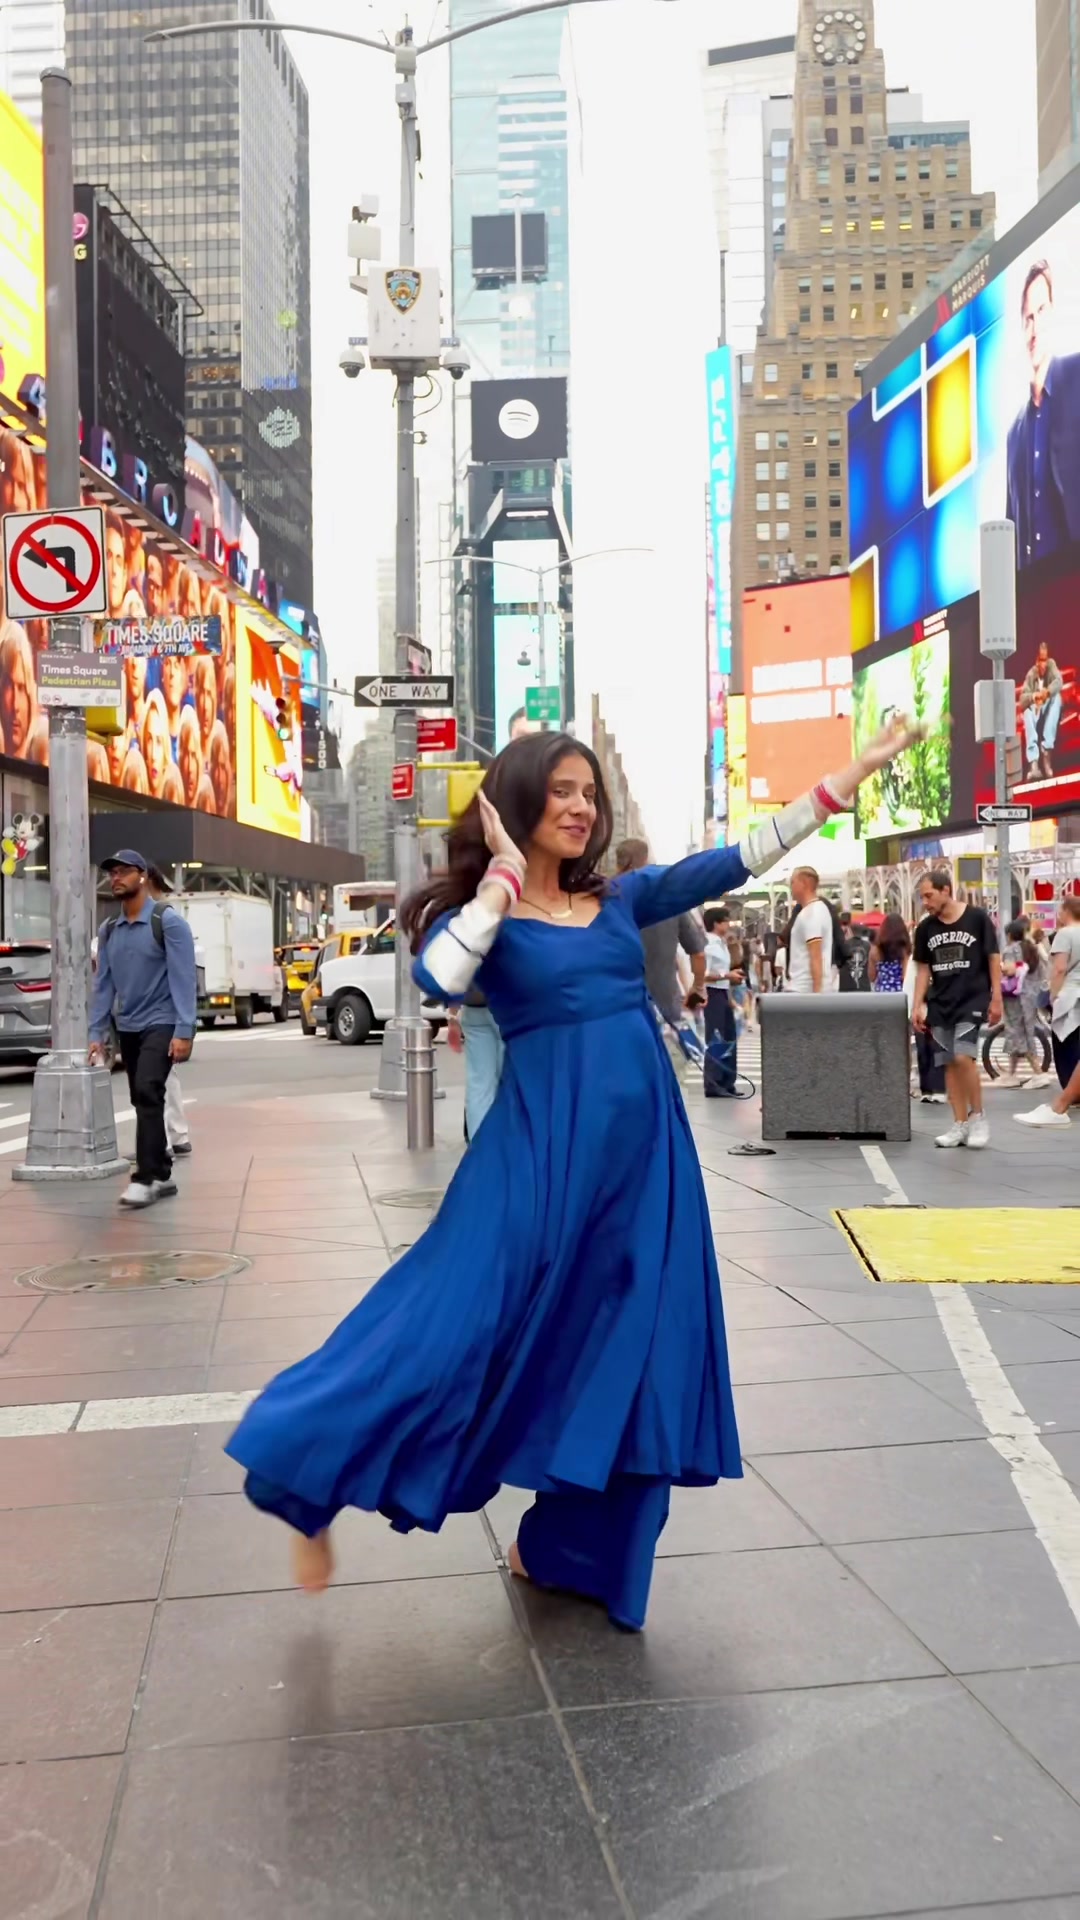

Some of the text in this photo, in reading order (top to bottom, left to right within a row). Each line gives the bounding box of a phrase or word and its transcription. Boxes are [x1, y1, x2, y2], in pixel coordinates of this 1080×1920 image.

[952, 254, 990, 297] MARRIOTT
[952, 274, 985, 312] MARQUIS
[153, 621, 209, 643] SQUARE
[41, 665, 108, 677] Times Square
[41, 677, 117, 687] Pedestrian Plaza
[369, 685, 441, 698] ONE WAY
[927, 931, 976, 951] SUPERDRY
